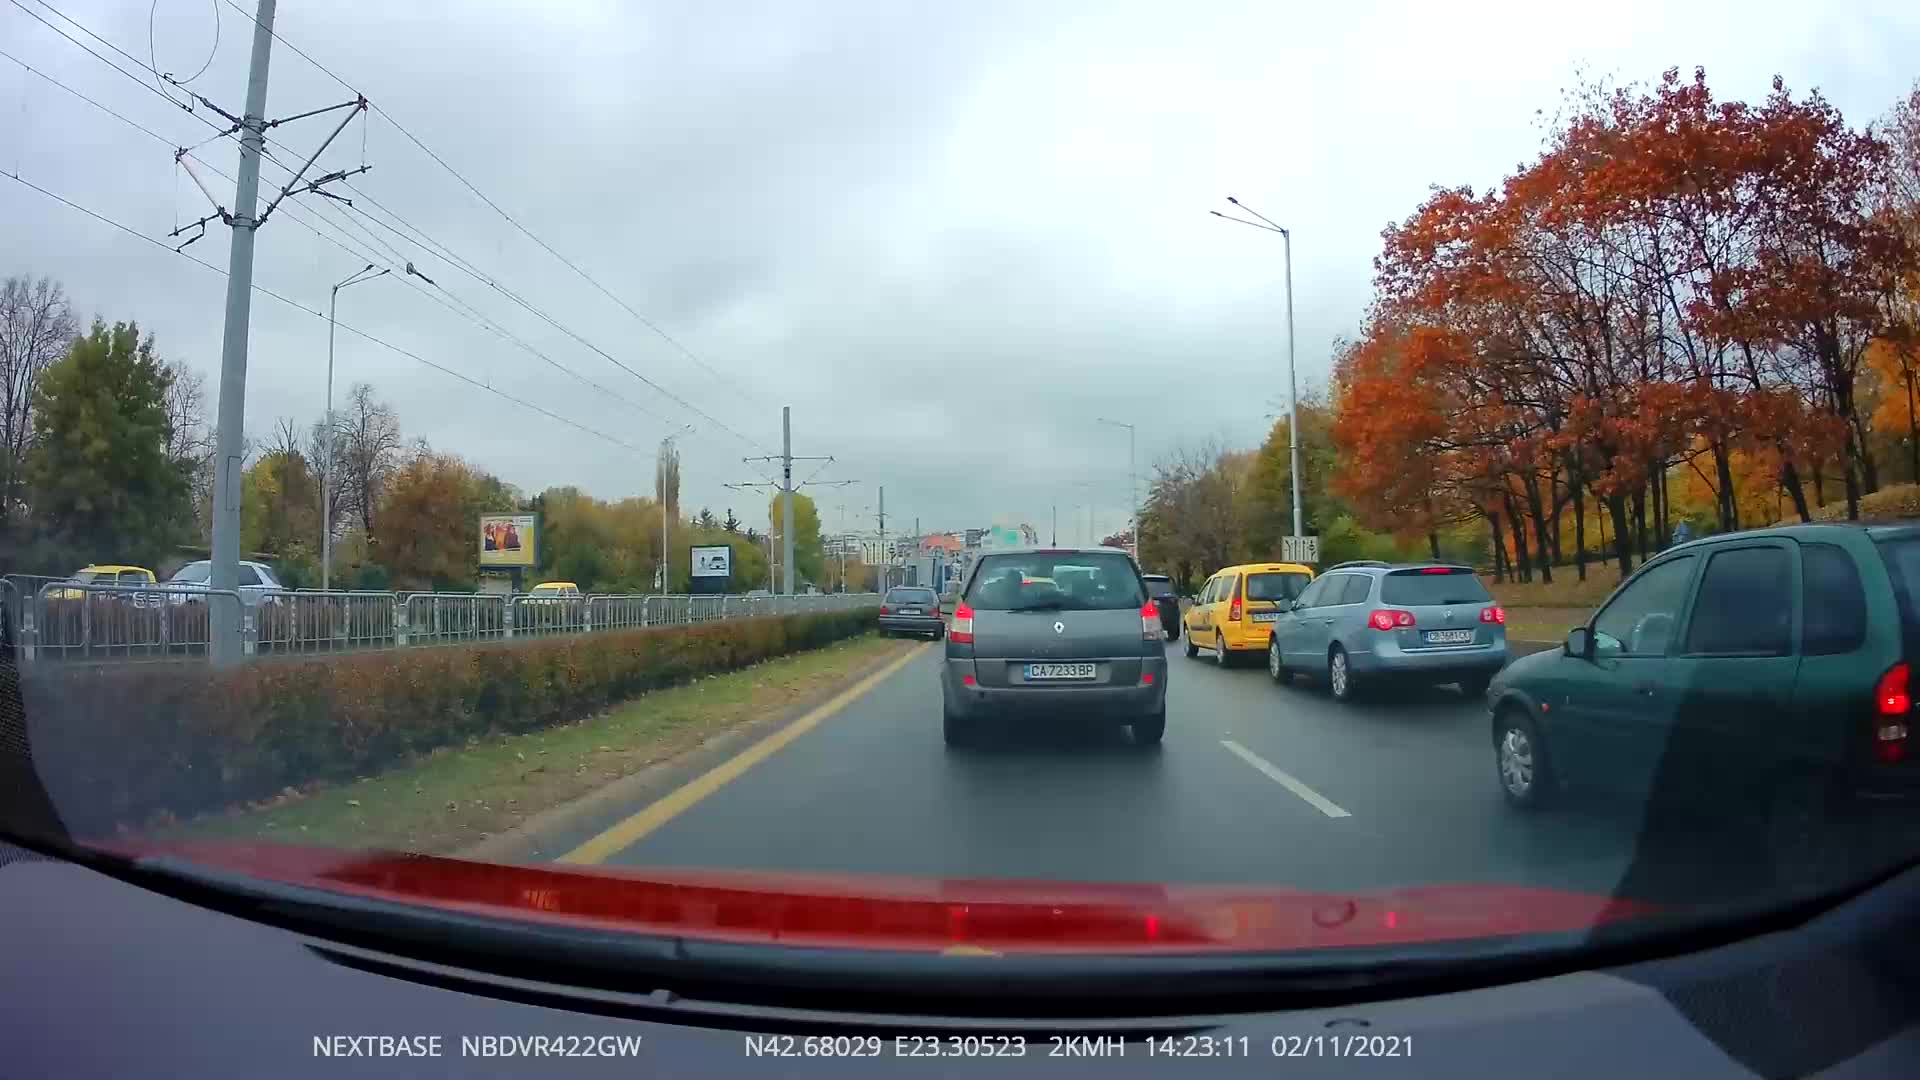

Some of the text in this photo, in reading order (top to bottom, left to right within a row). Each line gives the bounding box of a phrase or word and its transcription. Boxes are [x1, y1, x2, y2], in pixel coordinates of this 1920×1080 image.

[1031, 665, 1093, 677] CA 7233 BP
